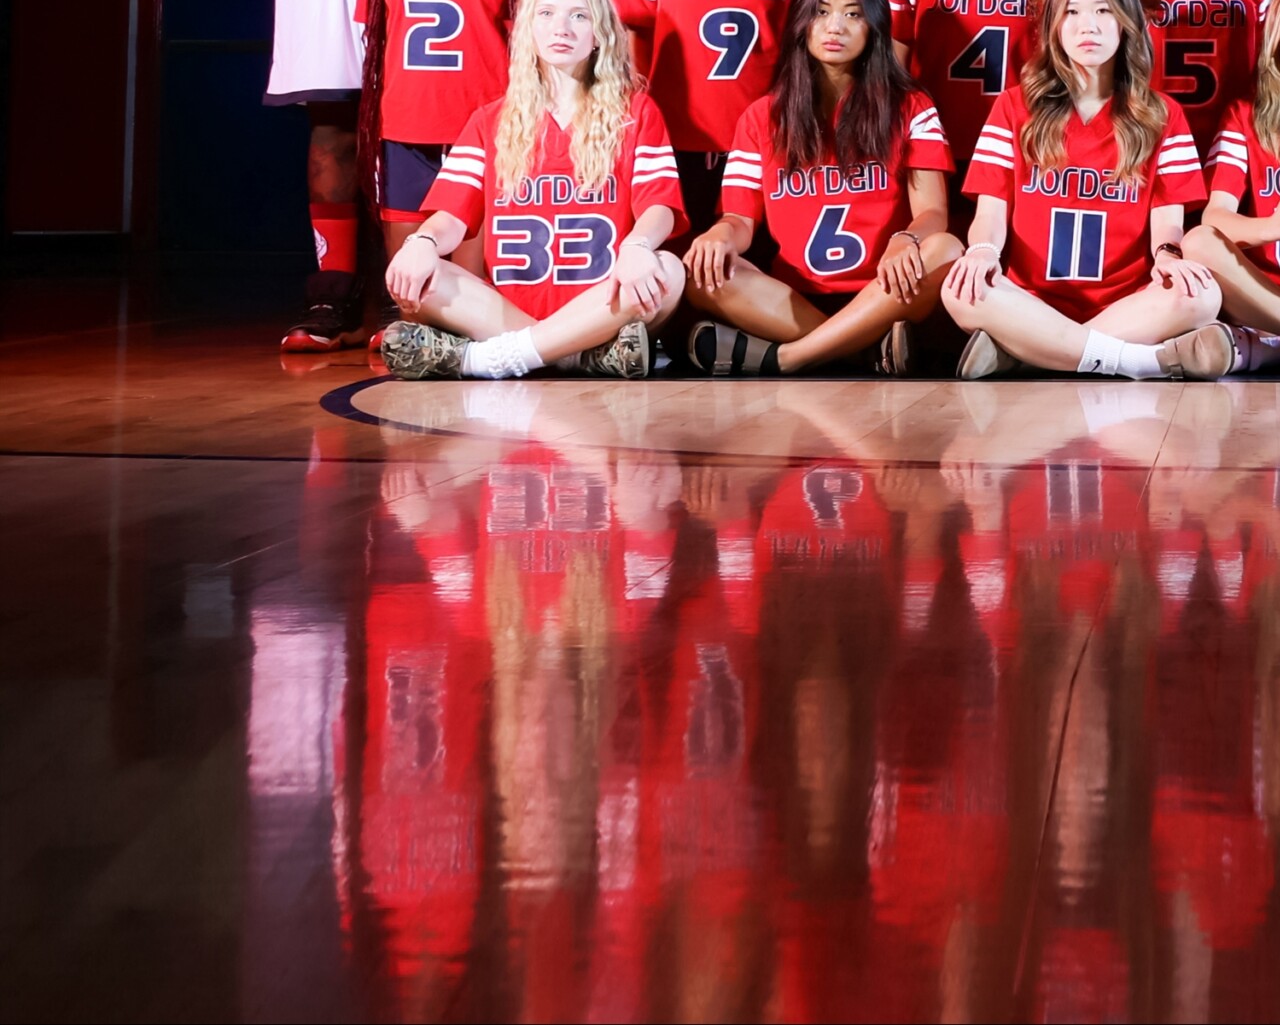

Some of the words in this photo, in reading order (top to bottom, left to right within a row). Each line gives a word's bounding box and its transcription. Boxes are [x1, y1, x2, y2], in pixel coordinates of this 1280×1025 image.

[698, 7, 761, 81] 9
[946, 25, 1010, 96] 4
[1162, 38, 1219, 108] 5
[492, 213, 618, 286] 33
[804, 203, 867, 276] 6
[1046, 206, 1108, 282] 11
